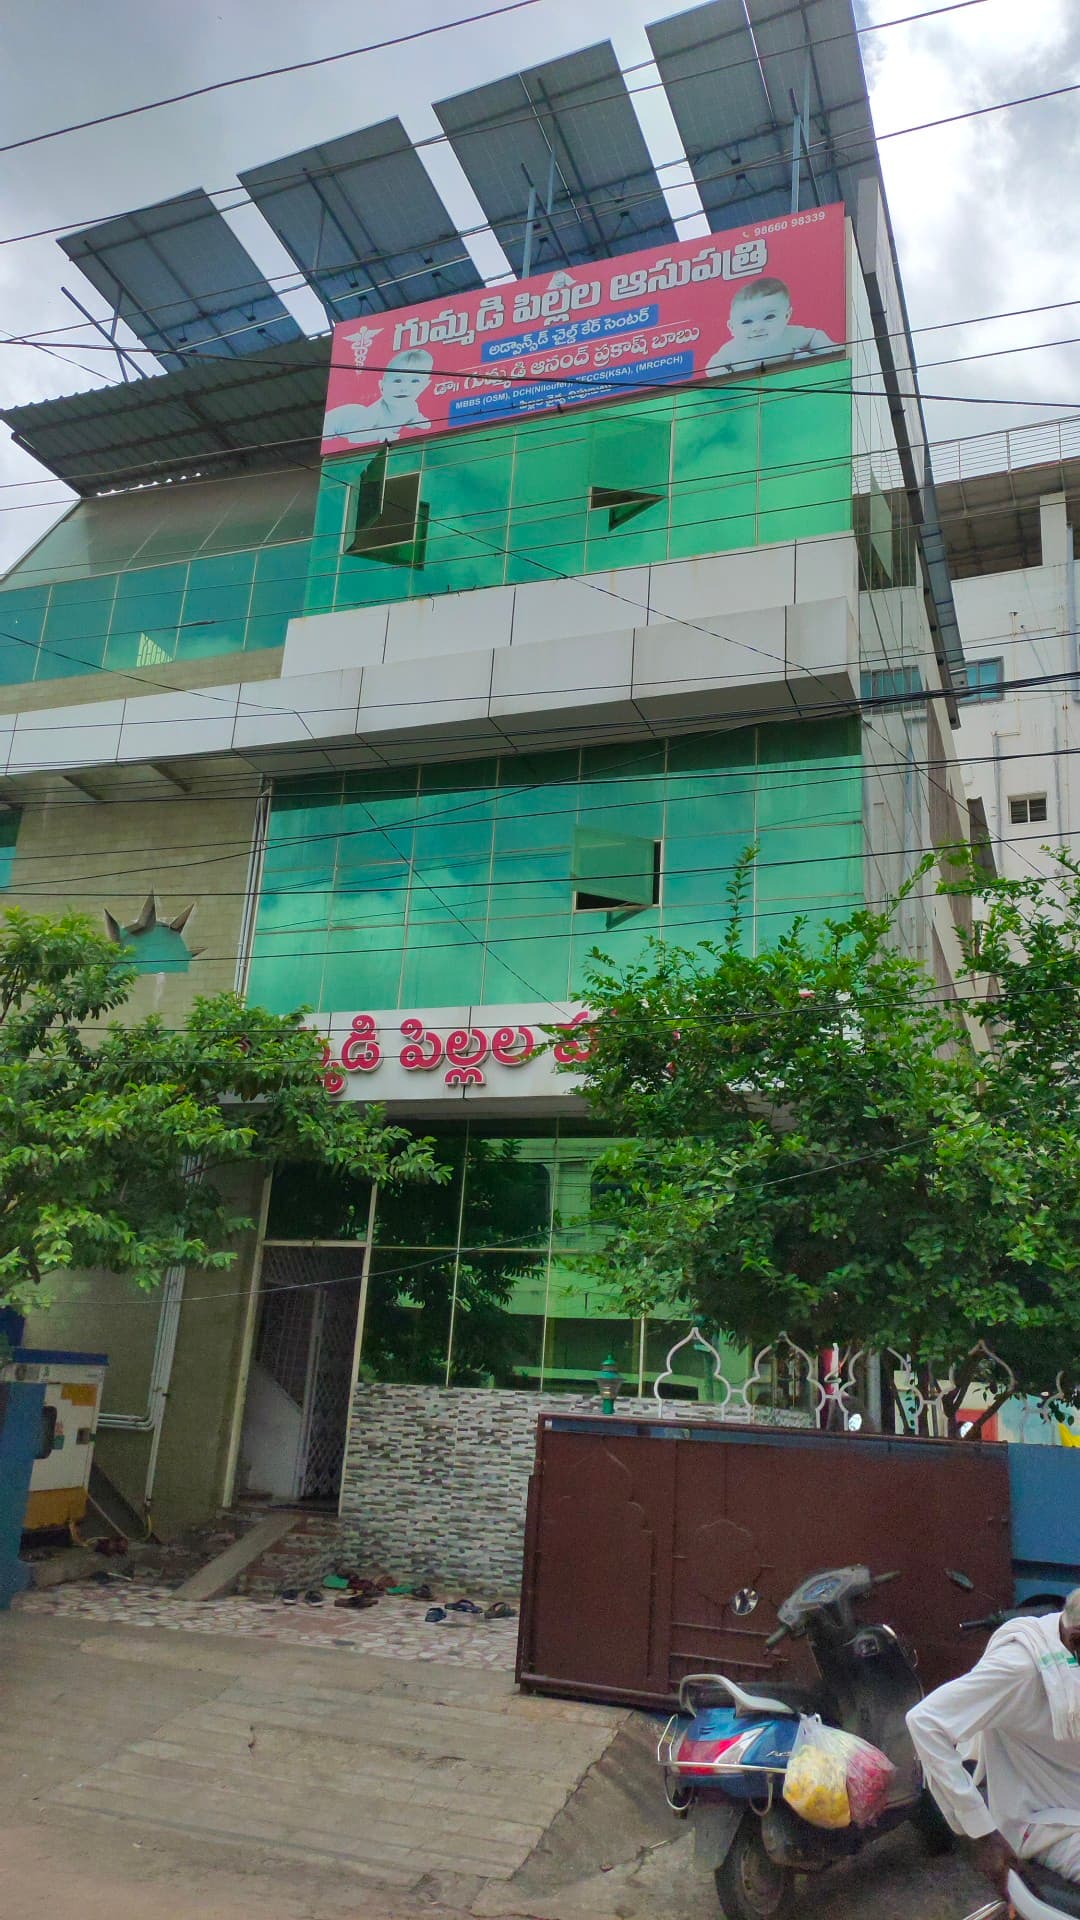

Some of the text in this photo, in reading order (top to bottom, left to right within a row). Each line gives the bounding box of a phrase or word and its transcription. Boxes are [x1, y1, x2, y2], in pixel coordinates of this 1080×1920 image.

[754, 211, 826, 237] 98660 98339
[393, 239, 768, 351] గుమ్మడి పిల్లల ఆసుపత్రి
[581, 316, 602, 335] కేర్
[604, 306, 650, 331] సెంటర్
[530, 345, 590, 374] ఆనంద్
[652, 327, 700, 349] బాబు
[455, 399, 481, 409] MBBS
[635, 354, 684, 373] (MRCPCH)
[400, 1018, 535, 1086] పిల్లల
